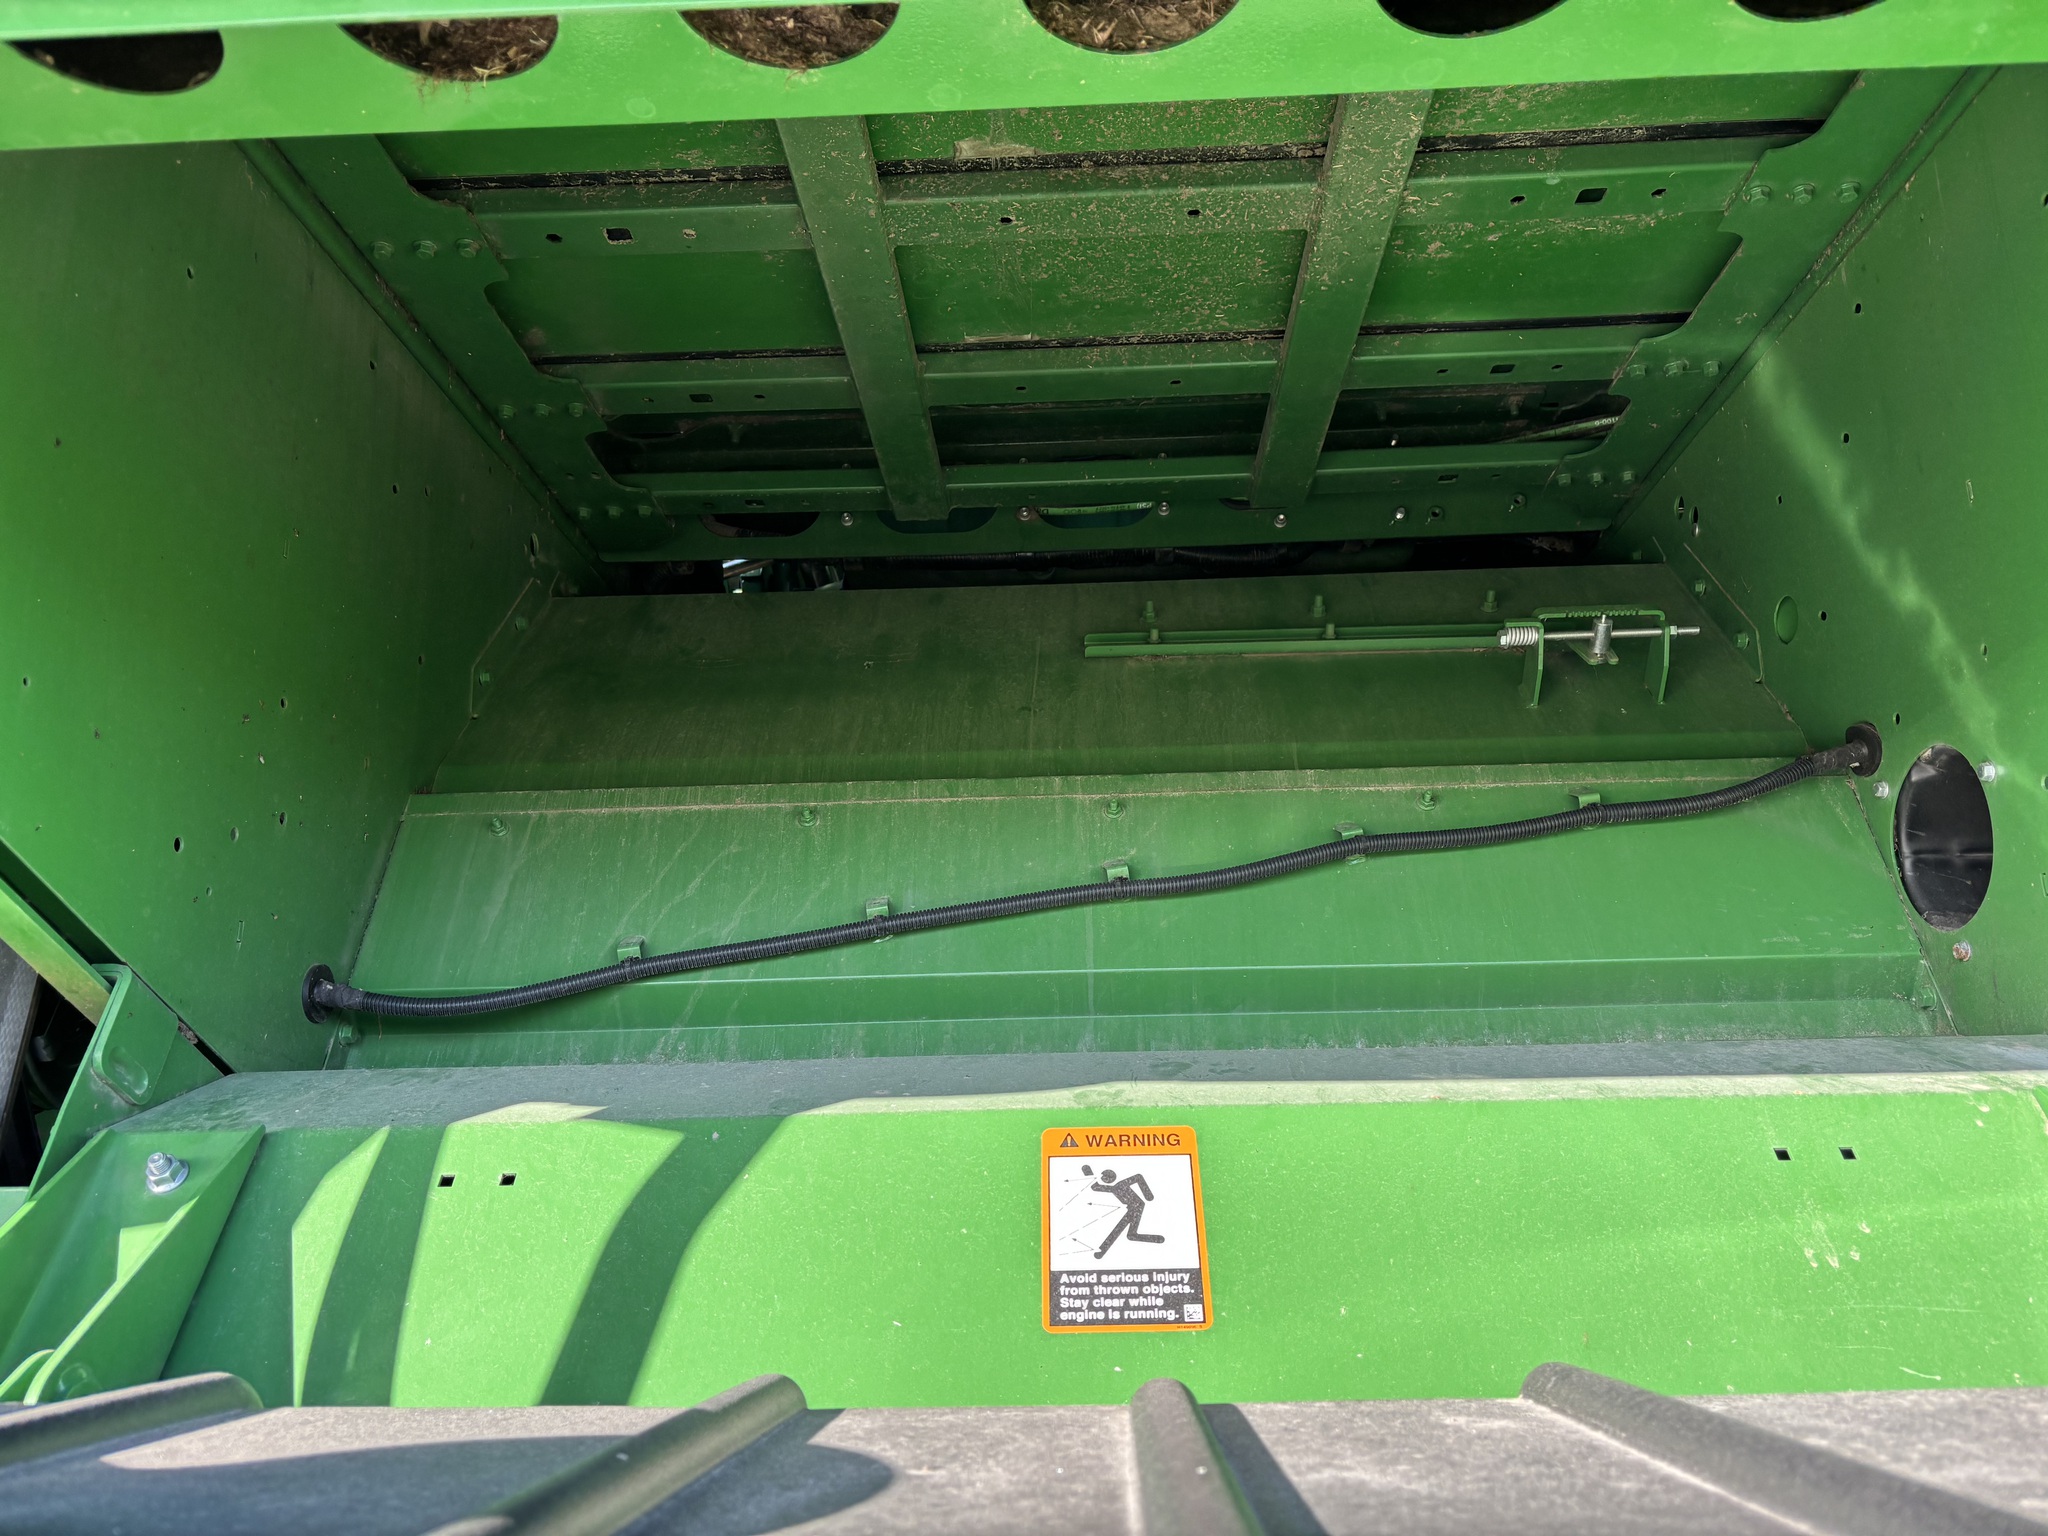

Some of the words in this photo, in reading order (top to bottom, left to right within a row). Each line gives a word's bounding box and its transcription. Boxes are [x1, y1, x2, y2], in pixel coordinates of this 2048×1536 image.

[1085, 1133, 1181, 1147] WARNING
[1059, 1273, 1098, 1284] Avoid
[1101, 1272, 1149, 1283] serious
[1153, 1271, 1190, 1284] injury
[1059, 1285, 1090, 1296] from
[1093, 1285, 1139, 1295] thrown
[1142, 1283, 1195, 1297] objects.
[1059, 1297, 1090, 1310] Stay
[1092, 1297, 1125, 1307] clear
[1128, 1296, 1164, 1307] while
[1059, 1310, 1105, 1322] engine
[1108, 1308, 1121, 1320] is
[1124, 1308, 1180, 1321] running.
